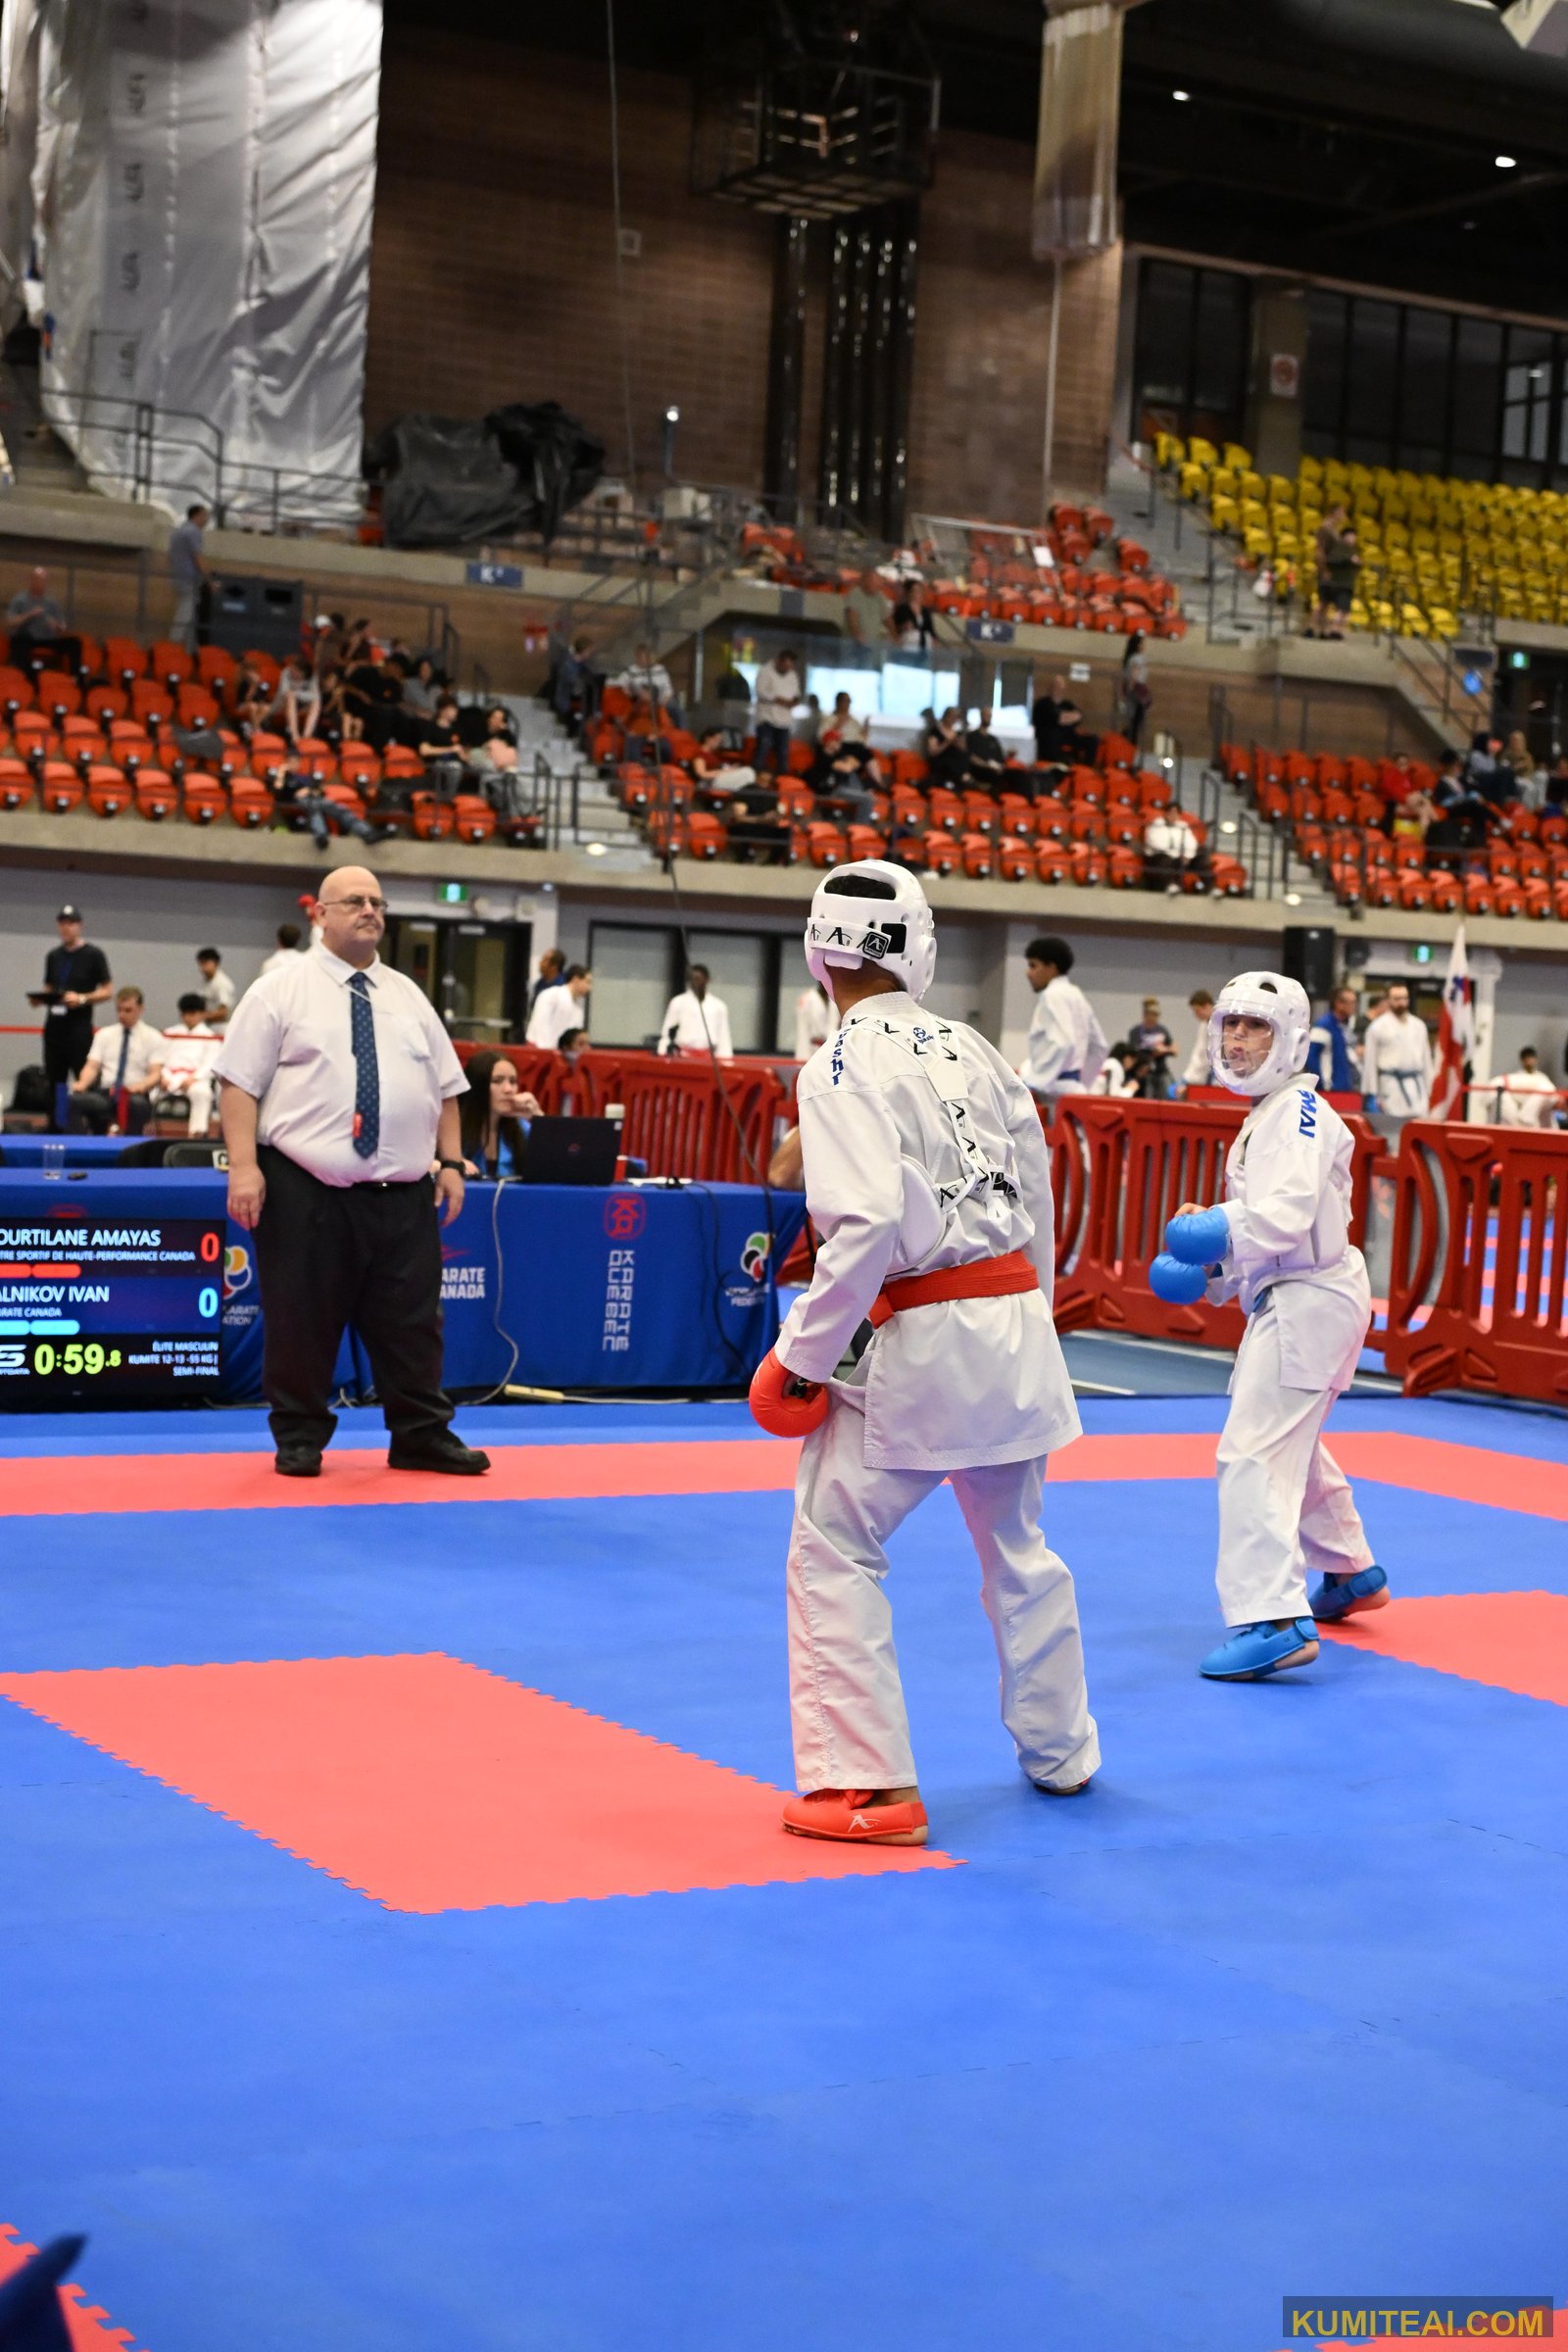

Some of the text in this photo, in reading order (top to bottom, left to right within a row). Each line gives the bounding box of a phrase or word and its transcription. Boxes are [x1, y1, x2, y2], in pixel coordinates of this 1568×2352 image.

[90, 1228, 162, 1247] AMAYAS
[200, 1232, 220, 1262] 0
[16, 1250, 51, 1261] SPORTIF
[52, 1250, 64, 1261] DE
[65, 1250, 158, 1261] HAUTE-PERFORMANCE
[159, 1250, 196, 1262] CANADA
[440, 1267, 486, 1284] ARATE
[0, 1285, 110, 1303] LNIKOV IVAN
[439, 1284, 486, 1299] ANADA
[198, 1287, 219, 1318] 0
[24, 1306, 63, 1318] CANADA
[174, 1341, 219, 1351] MASCULIN
[34, 1343, 122, 1375] 0:59.8
[128, 1353, 160, 1365] KUMITE
[201, 1353, 213, 1364] KG
[172, 1365, 220, 1377] SEMI-FINAL
